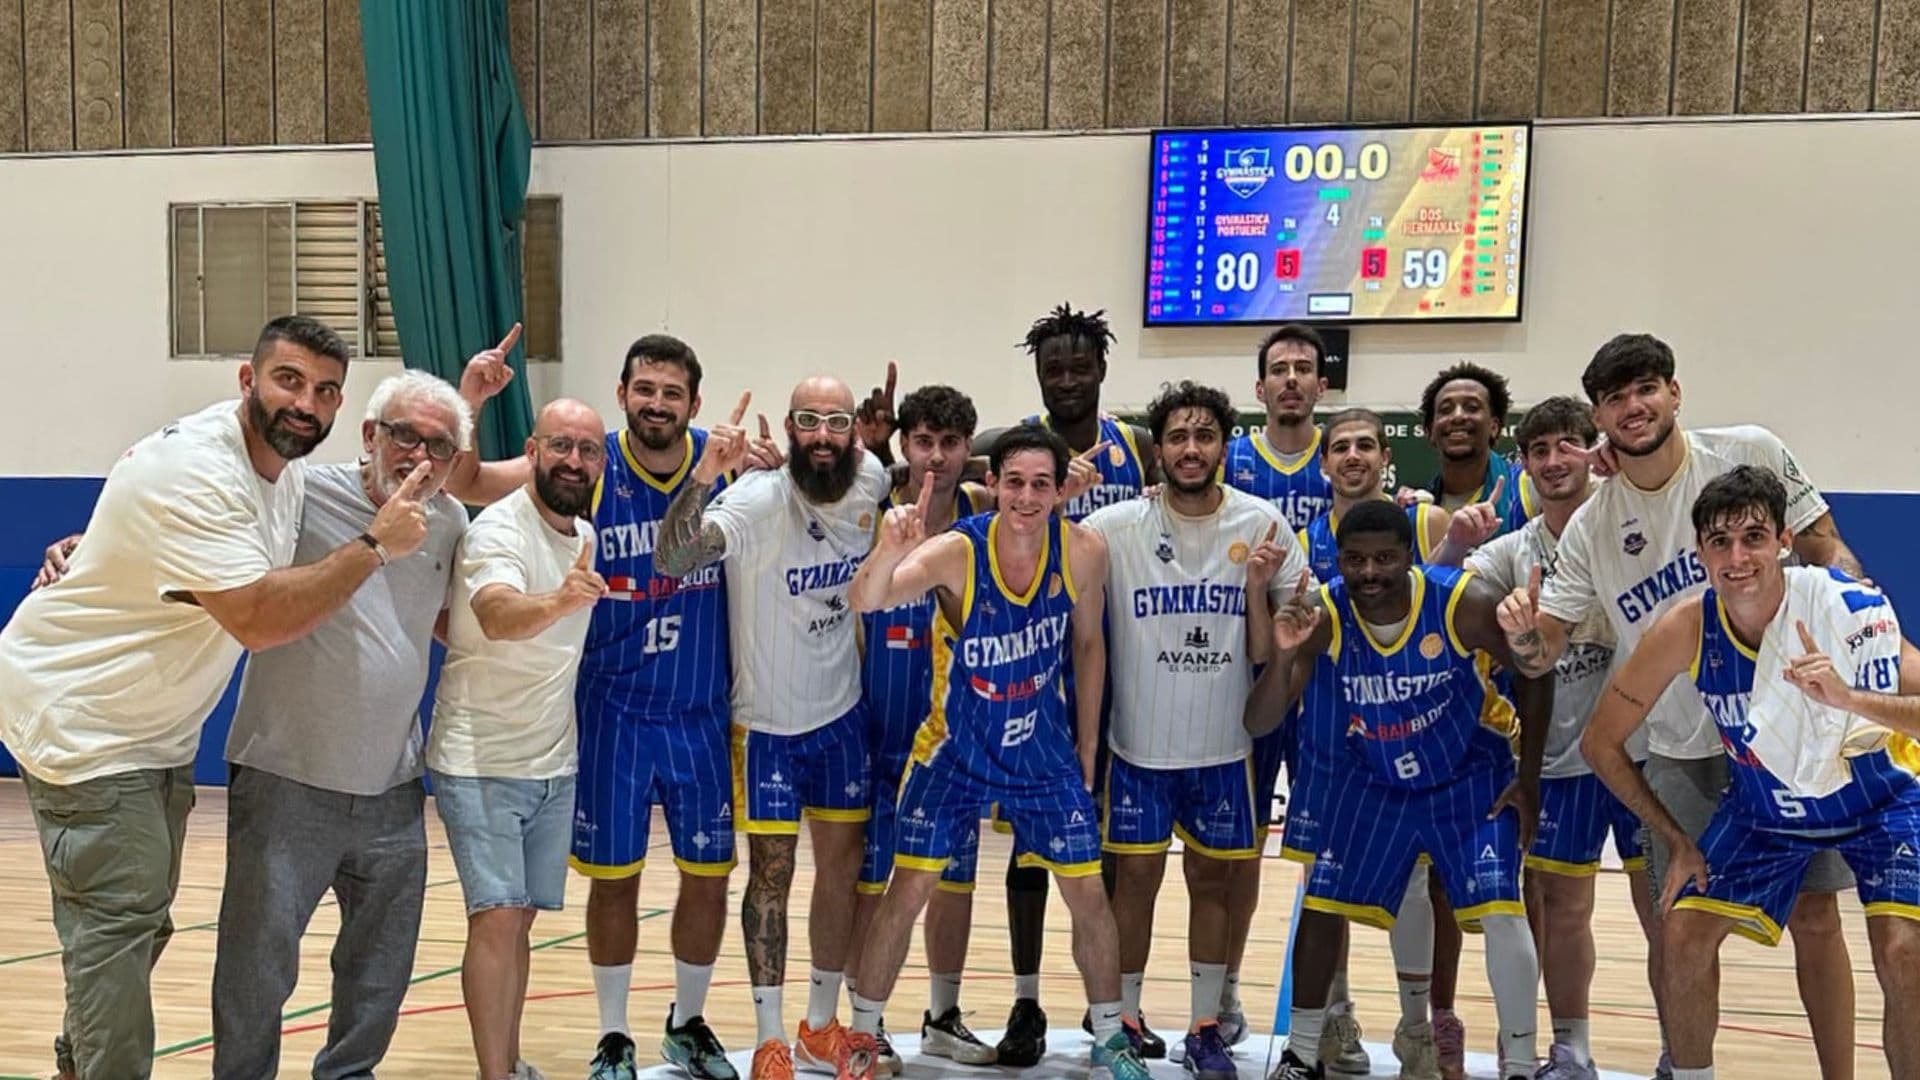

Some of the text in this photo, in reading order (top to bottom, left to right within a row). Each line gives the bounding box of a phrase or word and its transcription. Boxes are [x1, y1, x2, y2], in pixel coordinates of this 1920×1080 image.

[1285, 144, 1388, 180] 00.0
[1327, 203, 1340, 227] 4
[1215, 252, 1259, 291] 80
[1282, 255, 1294, 277] 5
[1368, 253, 1380, 276] 5
[1403, 249, 1447, 288] 59
[1384, 424, 1408, 437] DE
[1413, 424, 1426, 437] S
[643, 615, 682, 654] 15
[1156, 650, 1232, 665] AVANZA
[1001, 709, 1038, 747] 29
[1394, 751, 1421, 779] 6
[1772, 788, 1807, 818] 5
